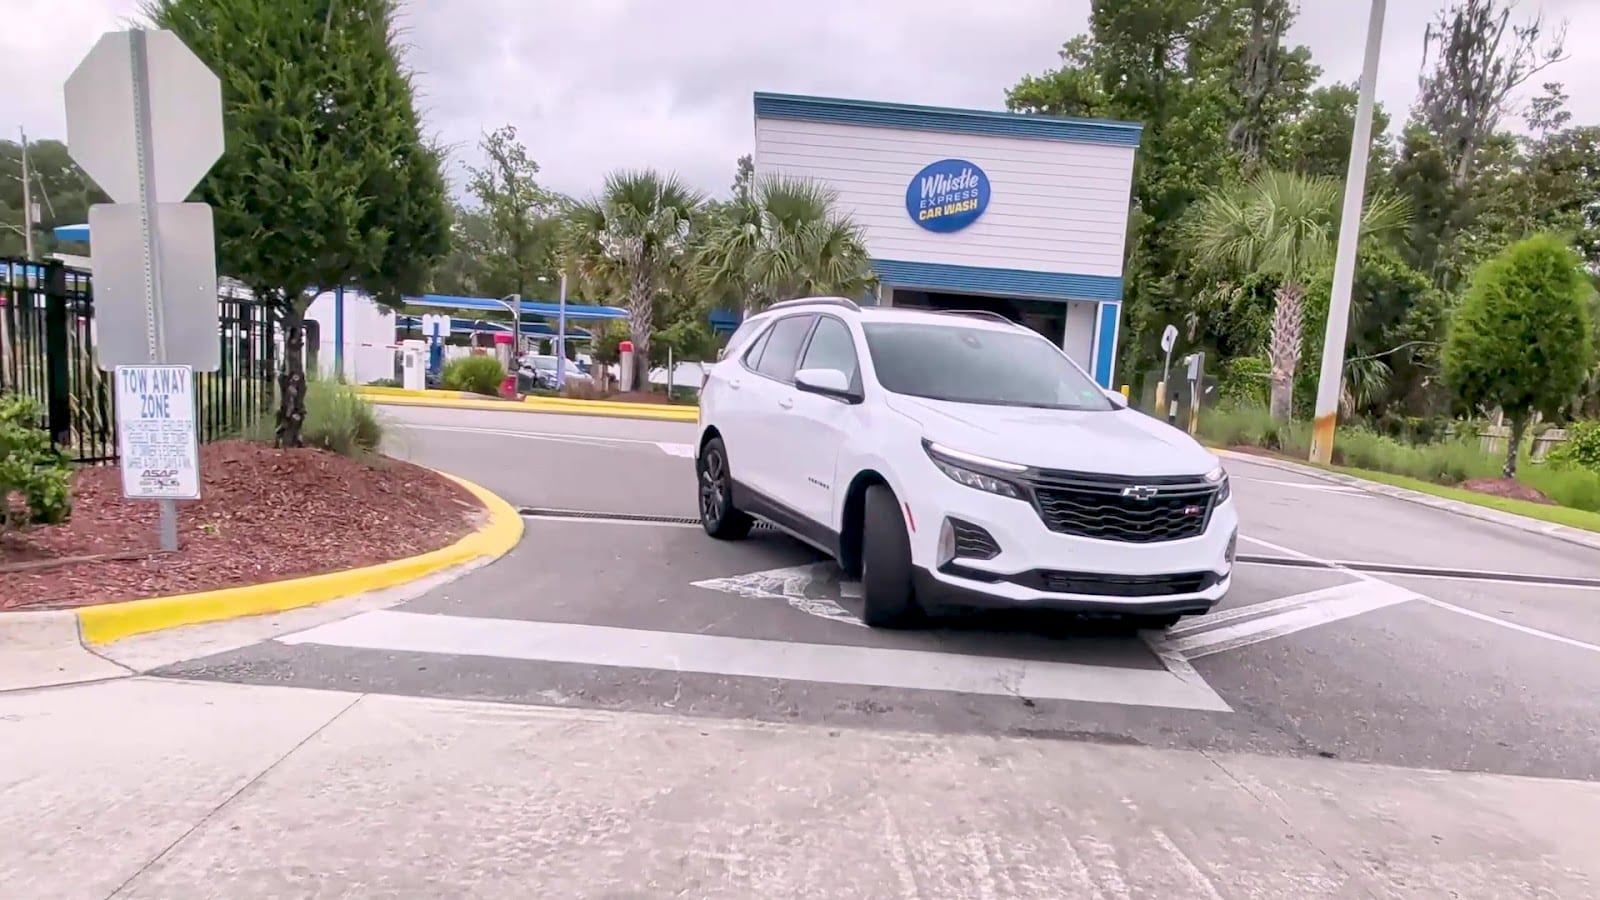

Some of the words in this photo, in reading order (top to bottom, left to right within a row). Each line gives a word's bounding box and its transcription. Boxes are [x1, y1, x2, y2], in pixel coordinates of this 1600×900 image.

[920, 168, 979, 199] Whistle
[919, 207, 942, 221] CAR
[944, 198, 979, 216] WASH
[920, 189, 979, 208] EXPRESS
[122, 369, 147, 394] TOW
[153, 368, 186, 394] AWAY
[141, 394, 170, 418] ZONE
[141, 469, 178, 477] ASAP
